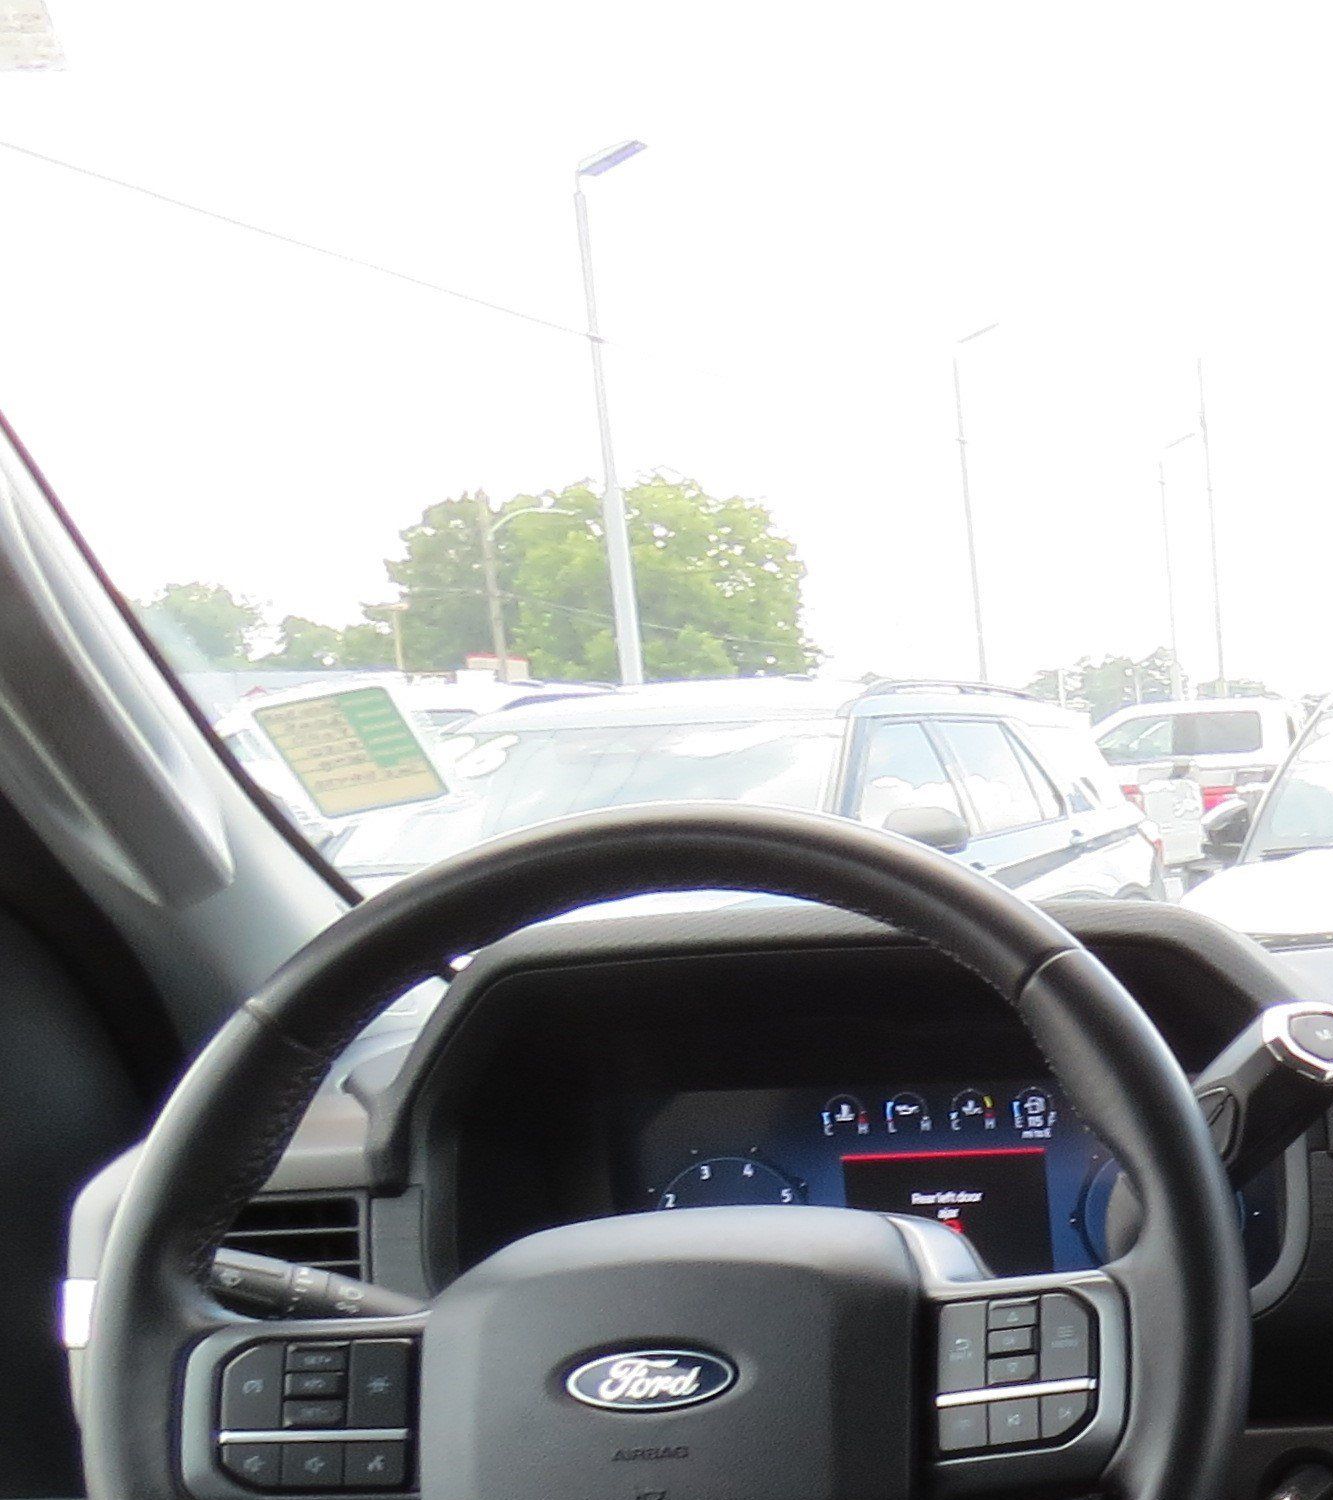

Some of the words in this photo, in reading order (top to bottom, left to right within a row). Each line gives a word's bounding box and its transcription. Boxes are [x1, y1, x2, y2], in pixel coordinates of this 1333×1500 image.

[700, 1166, 709, 1180] 3
[742, 1164, 752, 1177] 4
[665, 1193, 675, 1207] 2
[780, 1188, 791, 1202] 5
[599, 1358, 699, 1400] Ford
[613, 1446, 688, 1461] AIRBAG
